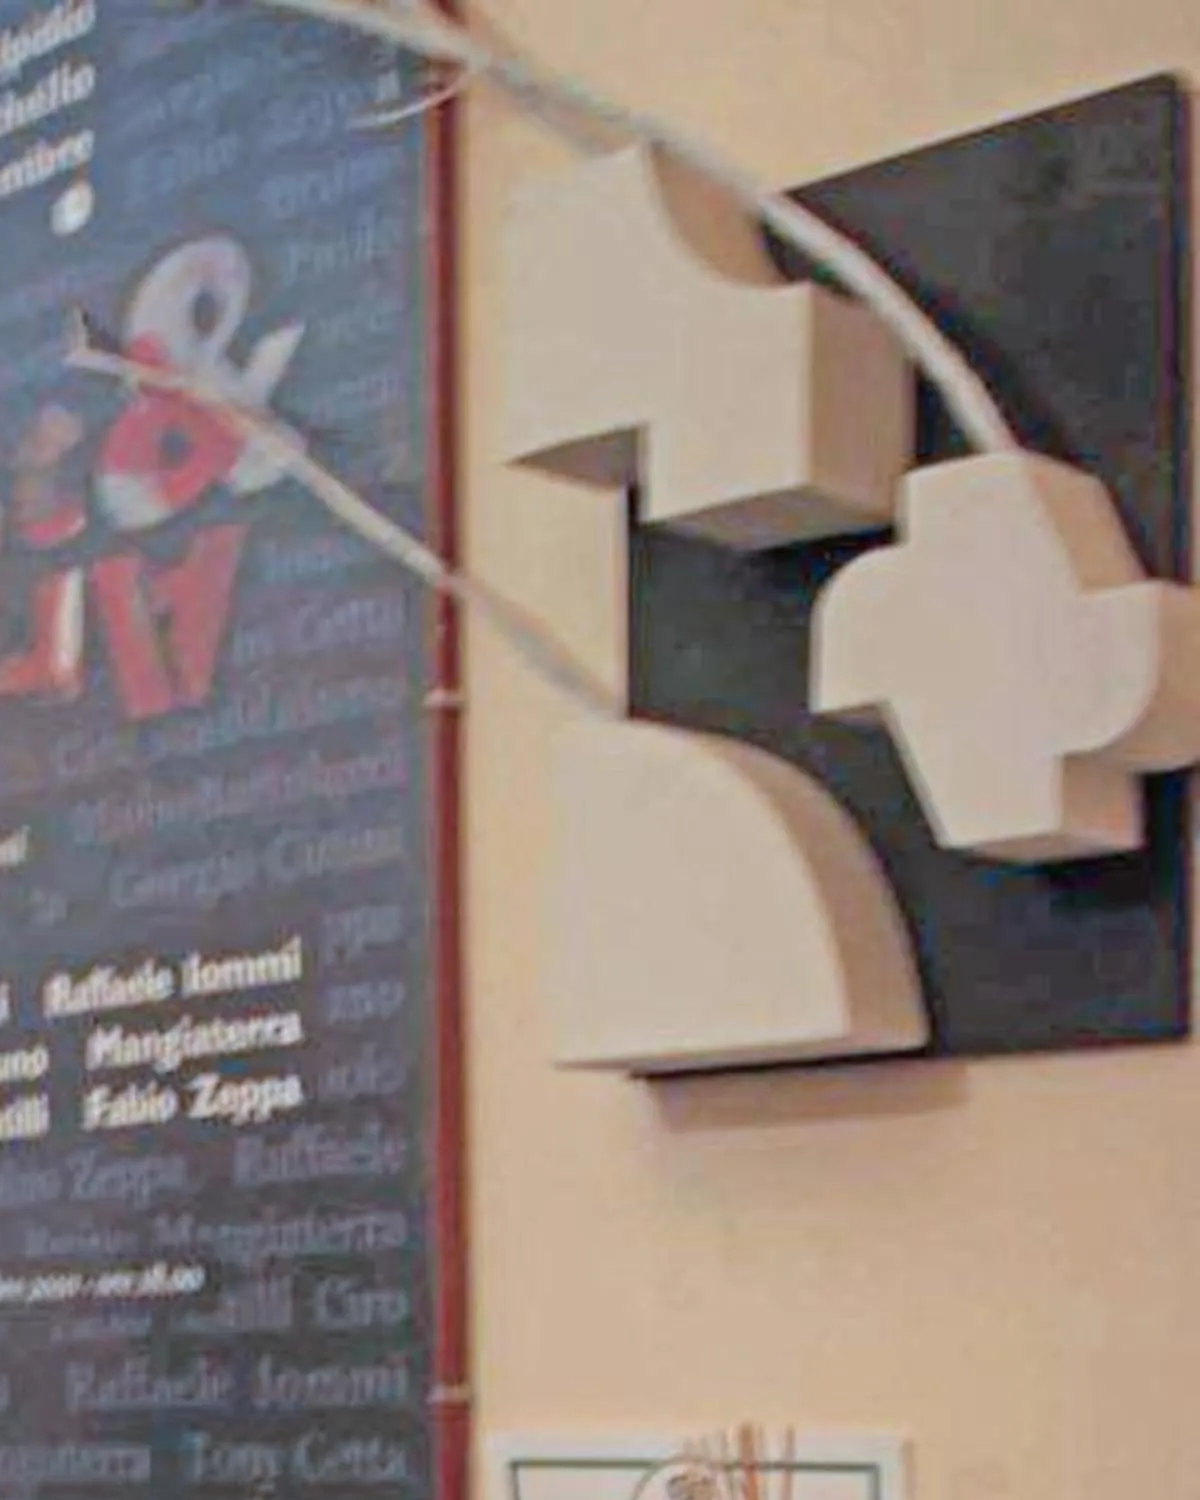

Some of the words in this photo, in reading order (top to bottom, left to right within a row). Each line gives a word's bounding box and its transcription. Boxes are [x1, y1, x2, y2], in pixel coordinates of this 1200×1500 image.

[42, 956, 176, 1018] Raffaele
[82, 1082, 179, 1132] Fabio
[186, 1073, 304, 1127] Zeppa
